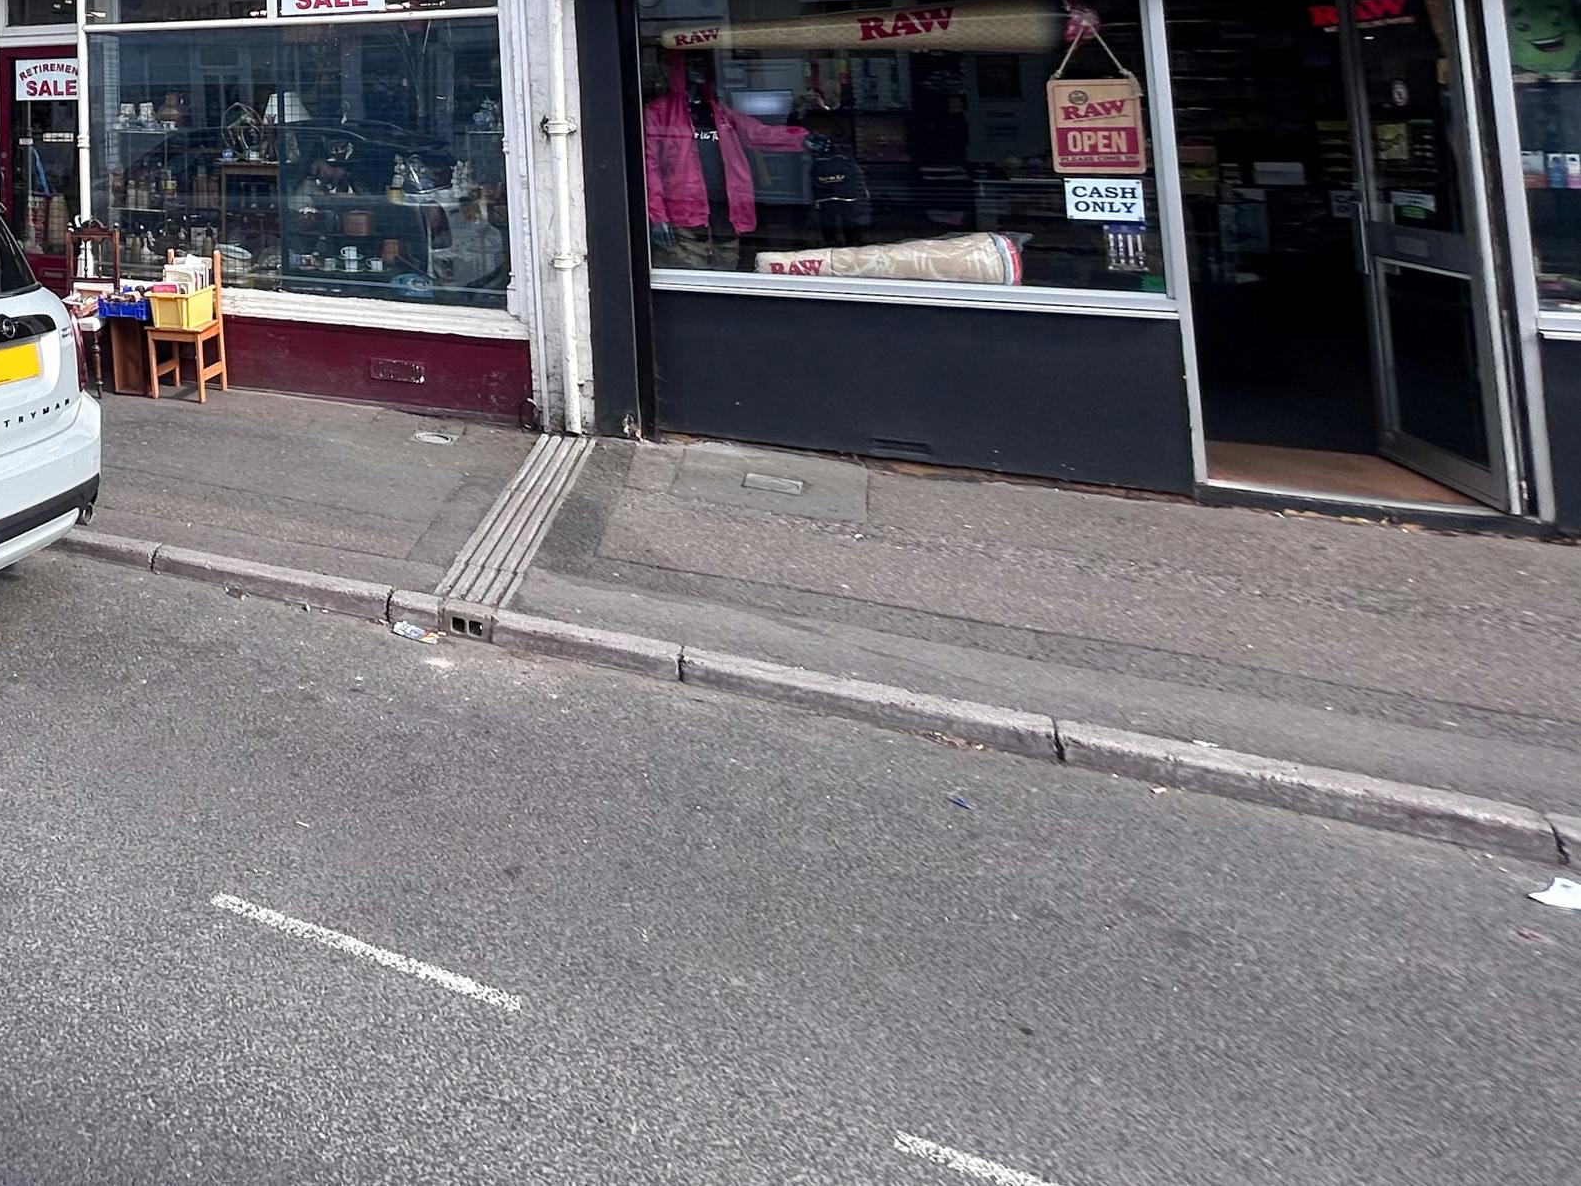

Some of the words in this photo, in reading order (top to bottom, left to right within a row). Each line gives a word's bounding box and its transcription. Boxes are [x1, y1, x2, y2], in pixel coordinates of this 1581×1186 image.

[856, 6, 955, 42] RAW
[674, 27, 720, 47] RAW
[19, 63, 79, 81] RETIREMEN
[25, 79, 78, 97] SALE
[1060, 98, 1127, 121] RAW
[1067, 130, 1128, 153] OPEN
[1071, 186, 1138, 199] CASH
[1074, 200, 1137, 214] ONLY
[769, 259, 824, 276] RAW
